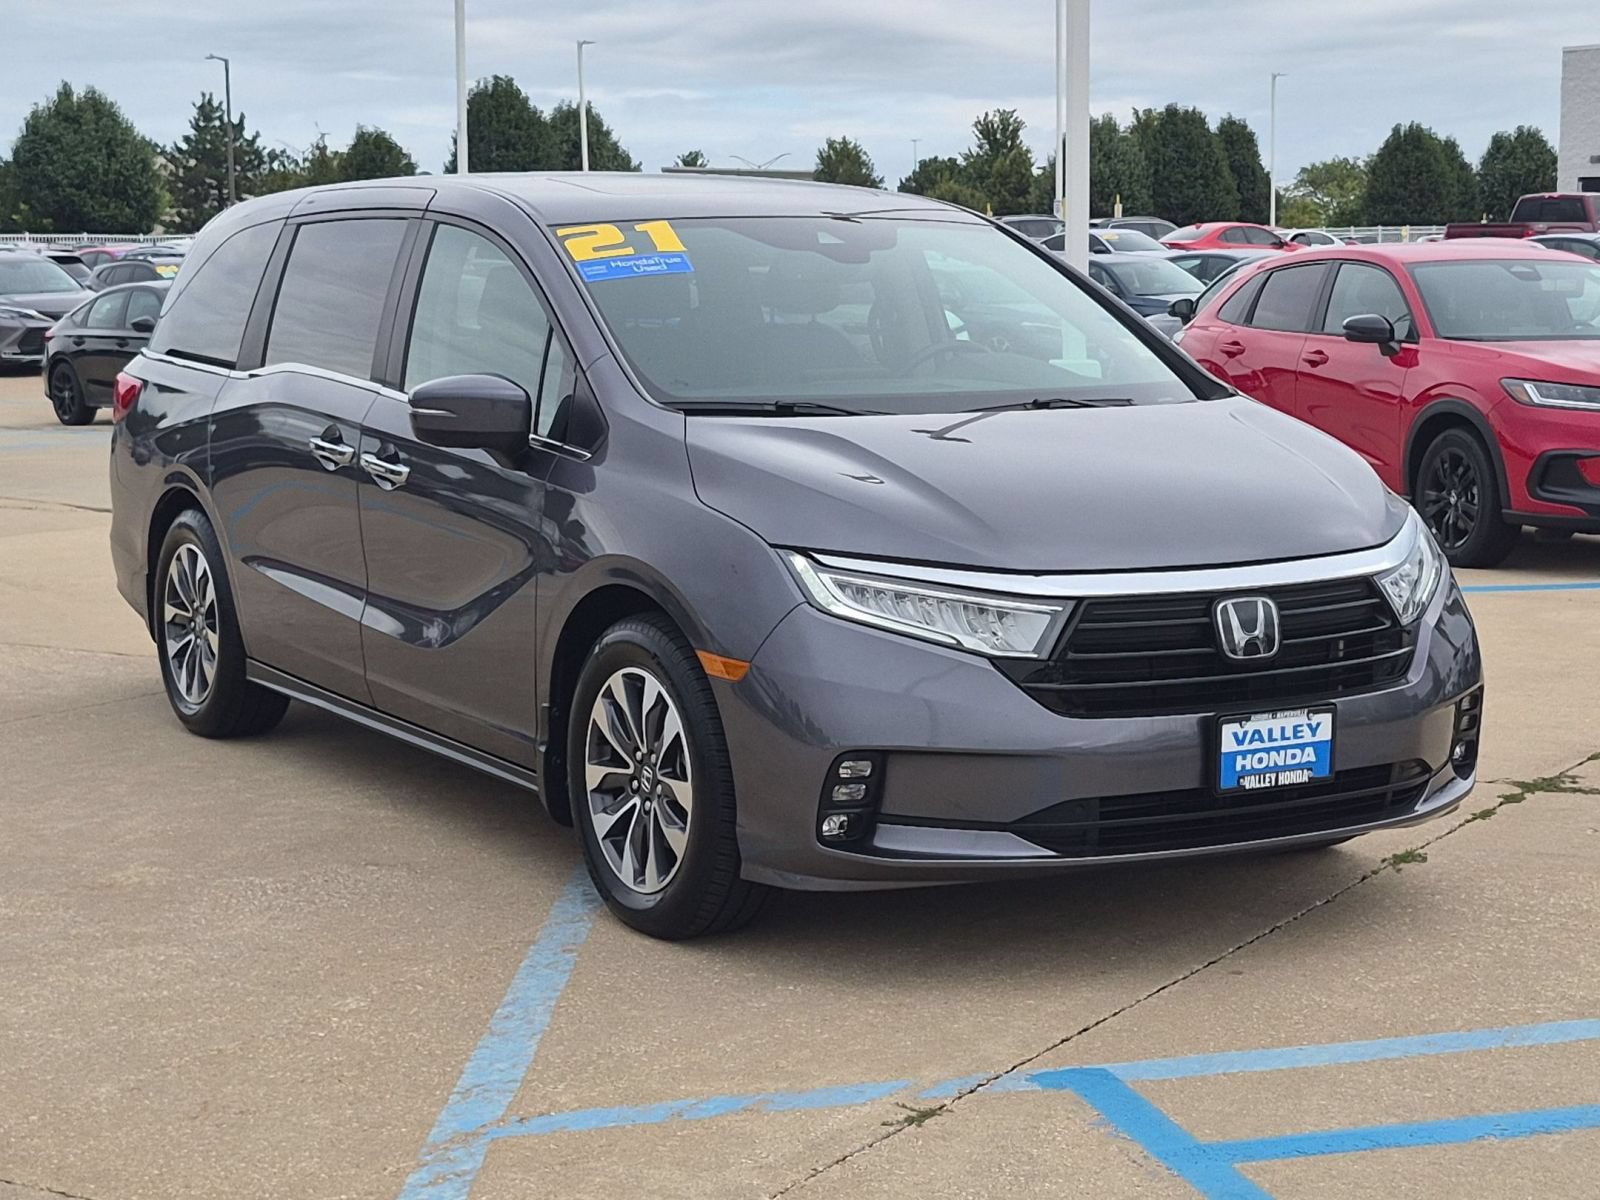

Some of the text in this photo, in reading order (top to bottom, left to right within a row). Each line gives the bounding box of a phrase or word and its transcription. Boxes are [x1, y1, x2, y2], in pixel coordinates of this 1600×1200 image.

[556, 220, 688, 261] 21
[633, 264, 667, 273] Used
[1232, 721, 1322, 747] VALLEY
[1235, 747, 1317, 771] HONDA
[1244, 769, 1309, 790] VALLEY HONDA
